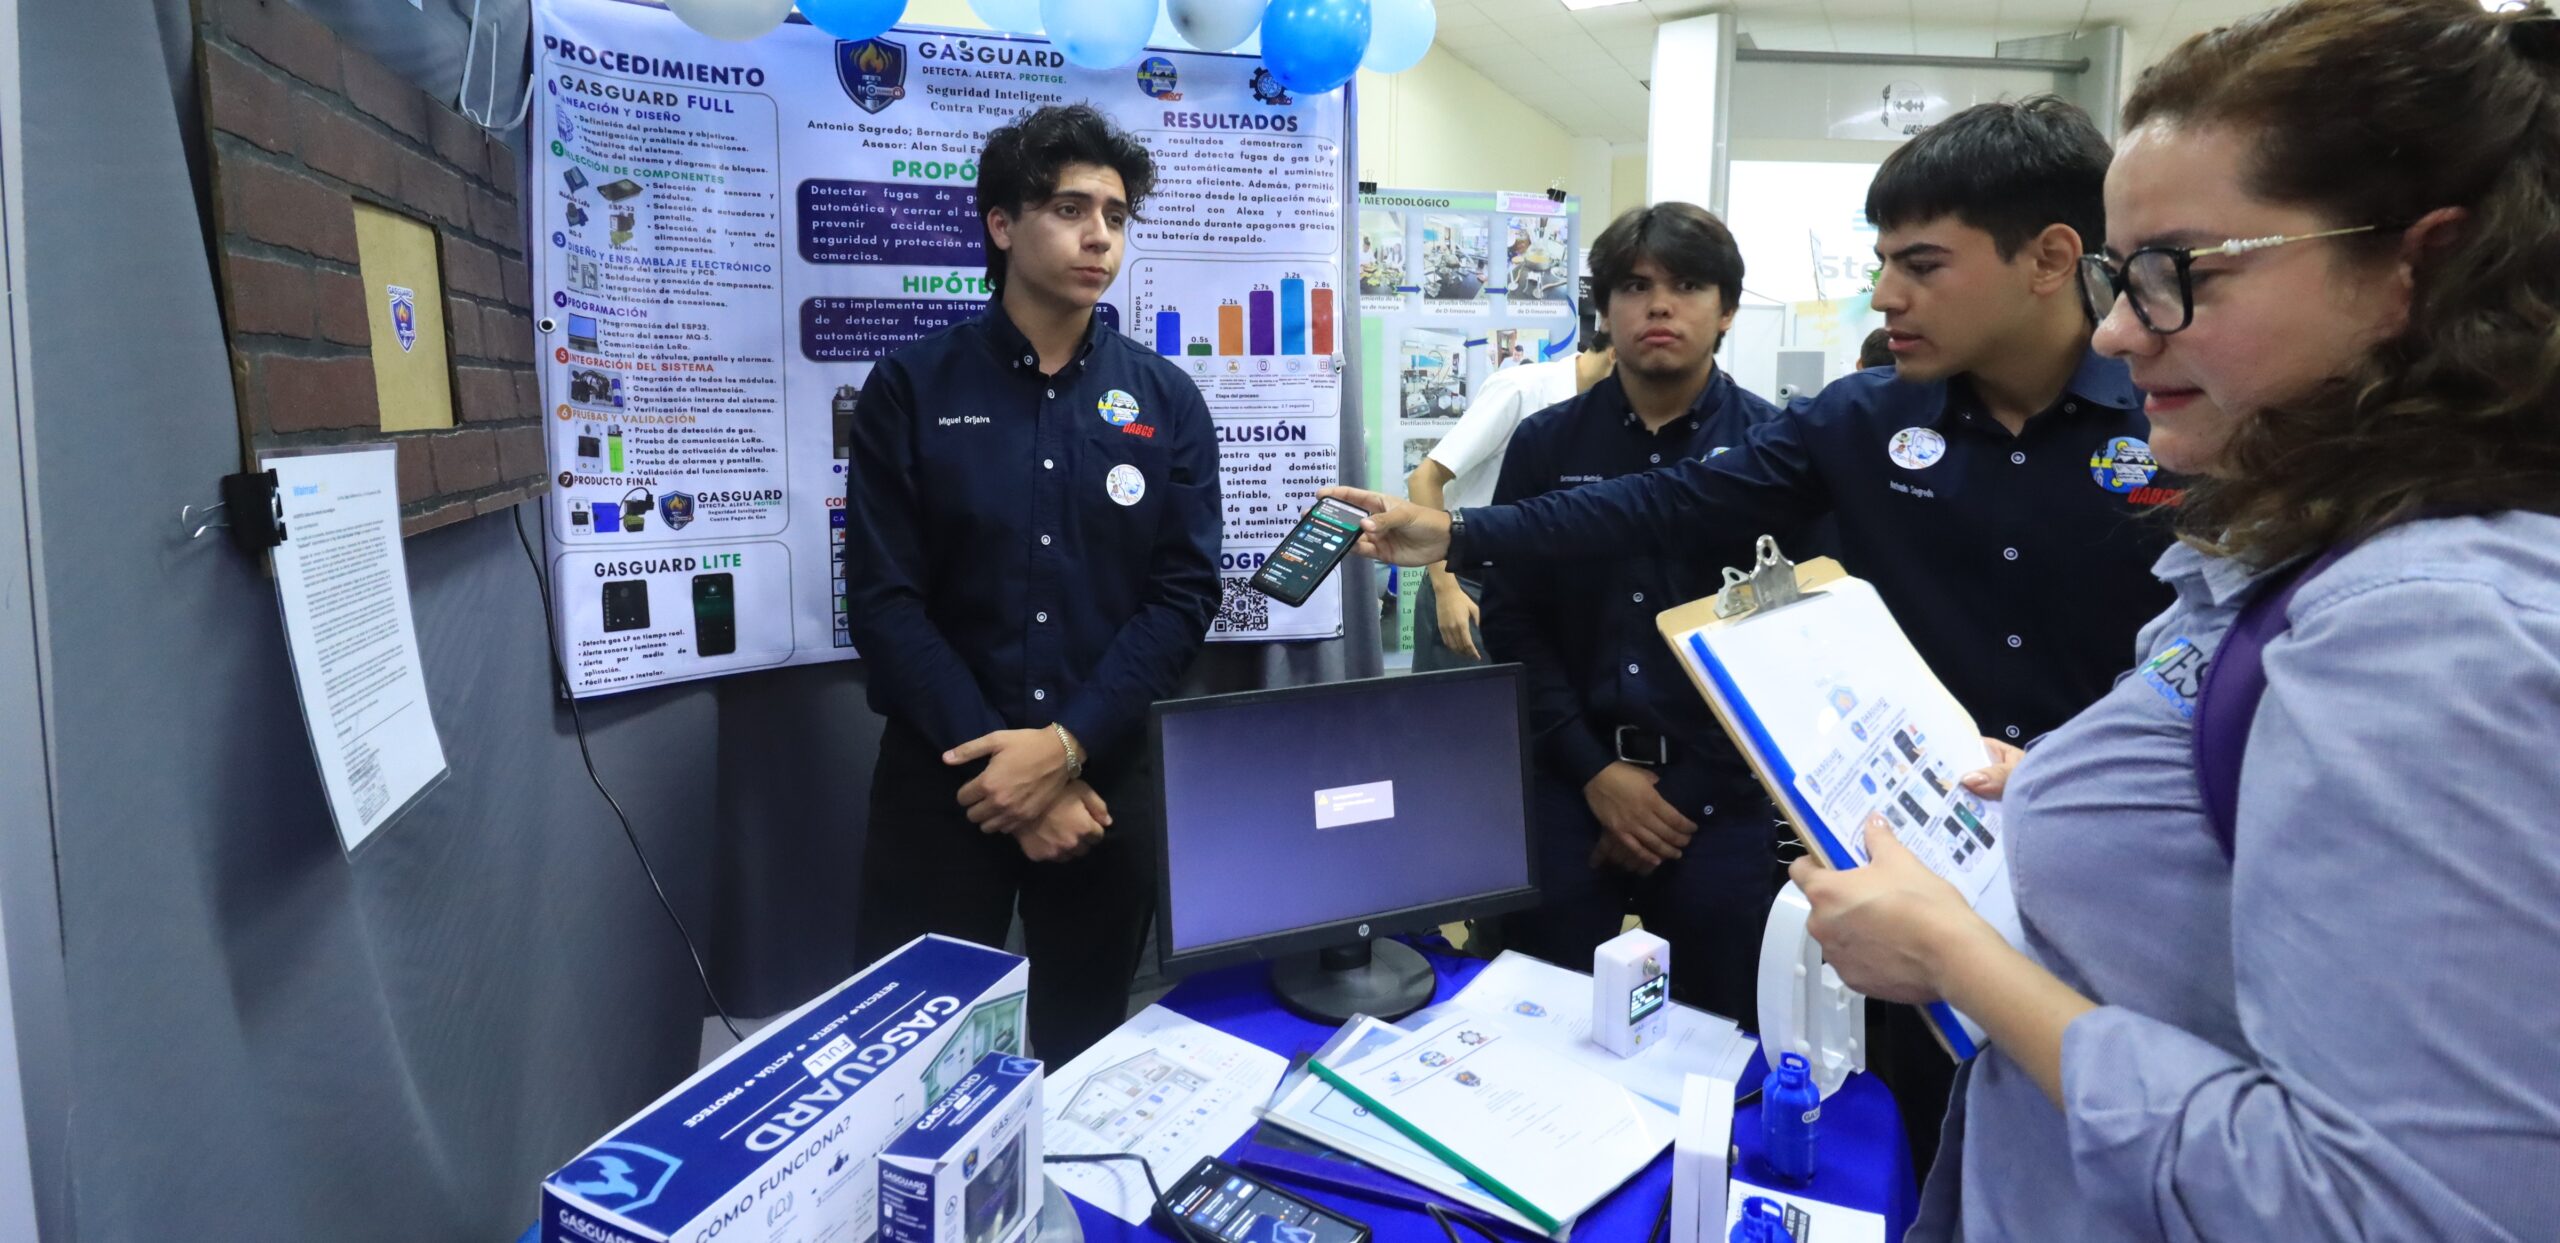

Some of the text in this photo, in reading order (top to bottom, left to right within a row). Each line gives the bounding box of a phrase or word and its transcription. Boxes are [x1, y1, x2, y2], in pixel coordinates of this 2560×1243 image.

[543, 34, 764, 87] PROCEDIMIENTO
[919, 42, 1065, 68] GASGUARD
[922, 66, 1066, 84] DETECTA. ALERTA. PROTEGE.
[560, 74, 734, 114] GASGUARD FULL
[927, 84, 1062, 104] Seguridad Inteligente
[624, 108, 680, 123] Y DISEÑO
[930, 101, 1014, 117] Contra Fugas
[1163, 111, 1297, 132] RESULTADOS
[808, 120, 854, 133] Antonio
[858, 123, 912, 137] Sagredo;
[917, 127, 969, 140] Bernardo
[862, 139, 907, 150] Asesor:
[911, 141, 938, 151] Alan
[941, 142, 966, 153] Saul
[1169, 136, 1333, 152] resultados demostraron que
[1194, 151, 1234, 159] detecta
[1240, 151, 1267, 162] fugas
[1291, 154, 1309, 164] gas
[1314, 155, 1324, 164] LP
[1330, 158, 1334, 166] y
[614, 165, 725, 184] DE COMPONENTES
[893, 158, 977, 181] PROPÓ
[1174, 163, 1333, 178] automáticamente el suministro
[1197, 177, 1333, 192] eficiente. Además, permitió
[811, 185, 950, 201] Detectar fugas de
[1205, 191, 1234, 200] desde
[1238, 193, 1247, 201] la
[1251, 193, 1304, 204] aplicación
[1307, 195, 1333, 205] móvil,
[812, 200, 958, 216] automática y cerrar el
[1364, 197, 1450, 208] METODOLÓGICO
[1159, 205, 1195, 213] control
[1237, 207, 1264, 216] Alexa
[1294, 208, 1334, 217] continuó
[813, 220, 963, 233] prevenir accidentes,
[1205, 220, 1335, 231] durante apagones gracias
[813, 235, 981, 249] seguridad y protección en
[1162, 231, 1199, 241] batería
[1203, 233, 1215, 241] de
[1218, 234, 1265, 244] respaldo.
[568, 241, 771, 273] DISEÑO Y ENSAMBLAJE ELECTRÓNICO
[813, 252, 883, 261] comercios.
[1822, 255, 1882, 279] Ste
[567, 296, 647, 318] PROGRAMACIÓN
[814, 300, 826, 309] Si
[850, 300, 923, 311] implementa
[929, 302, 942, 310] un
[815, 316, 948, 328] de detectar fugas
[816, 347, 885, 357] reducirá el
[570, 353, 714, 372] INTEGRACIÓN DEL SISTEMA
[573, 409, 696, 424] PRUEBAS Y VALIDACIÓN
[939, 416, 960, 426] Miguel
[1122, 423, 1155, 438] UABCS
[682, 436, 740, 445] comunicación
[1259, 452, 1276, 460] que
[703, 467, 768, 475] funcionamiento.
[1220, 464, 1271, 474] seguridad
[574, 476, 658, 486] PRODUCTO FINAL
[1227, 478, 1266, 486] sistema
[697, 490, 782, 503] GASGUARD
[1285, 491, 1315, 499] capaz
[1228, 505, 1240, 513] de
[1250, 505, 1268, 514] gas
[1277, 503, 1288, 512] LP
[1232, 518, 1298, 526] el suministro
[1234, 530, 1284, 540] eléctricos
[594, 553, 742, 578] GASGUARD LITE
[684, 981, 899, 1128] DETECTA ALERTA ACTÚA PROTEGE
[809, 1039, 852, 1068] FULL
[745, 995, 961, 1153] GASGUARD
[917, 1074, 981, 1129] GASGUARD
[694, 1115, 853, 1242] CÓMO FUNCIONA?
[883, 1170, 927, 1191] GASGUARD
